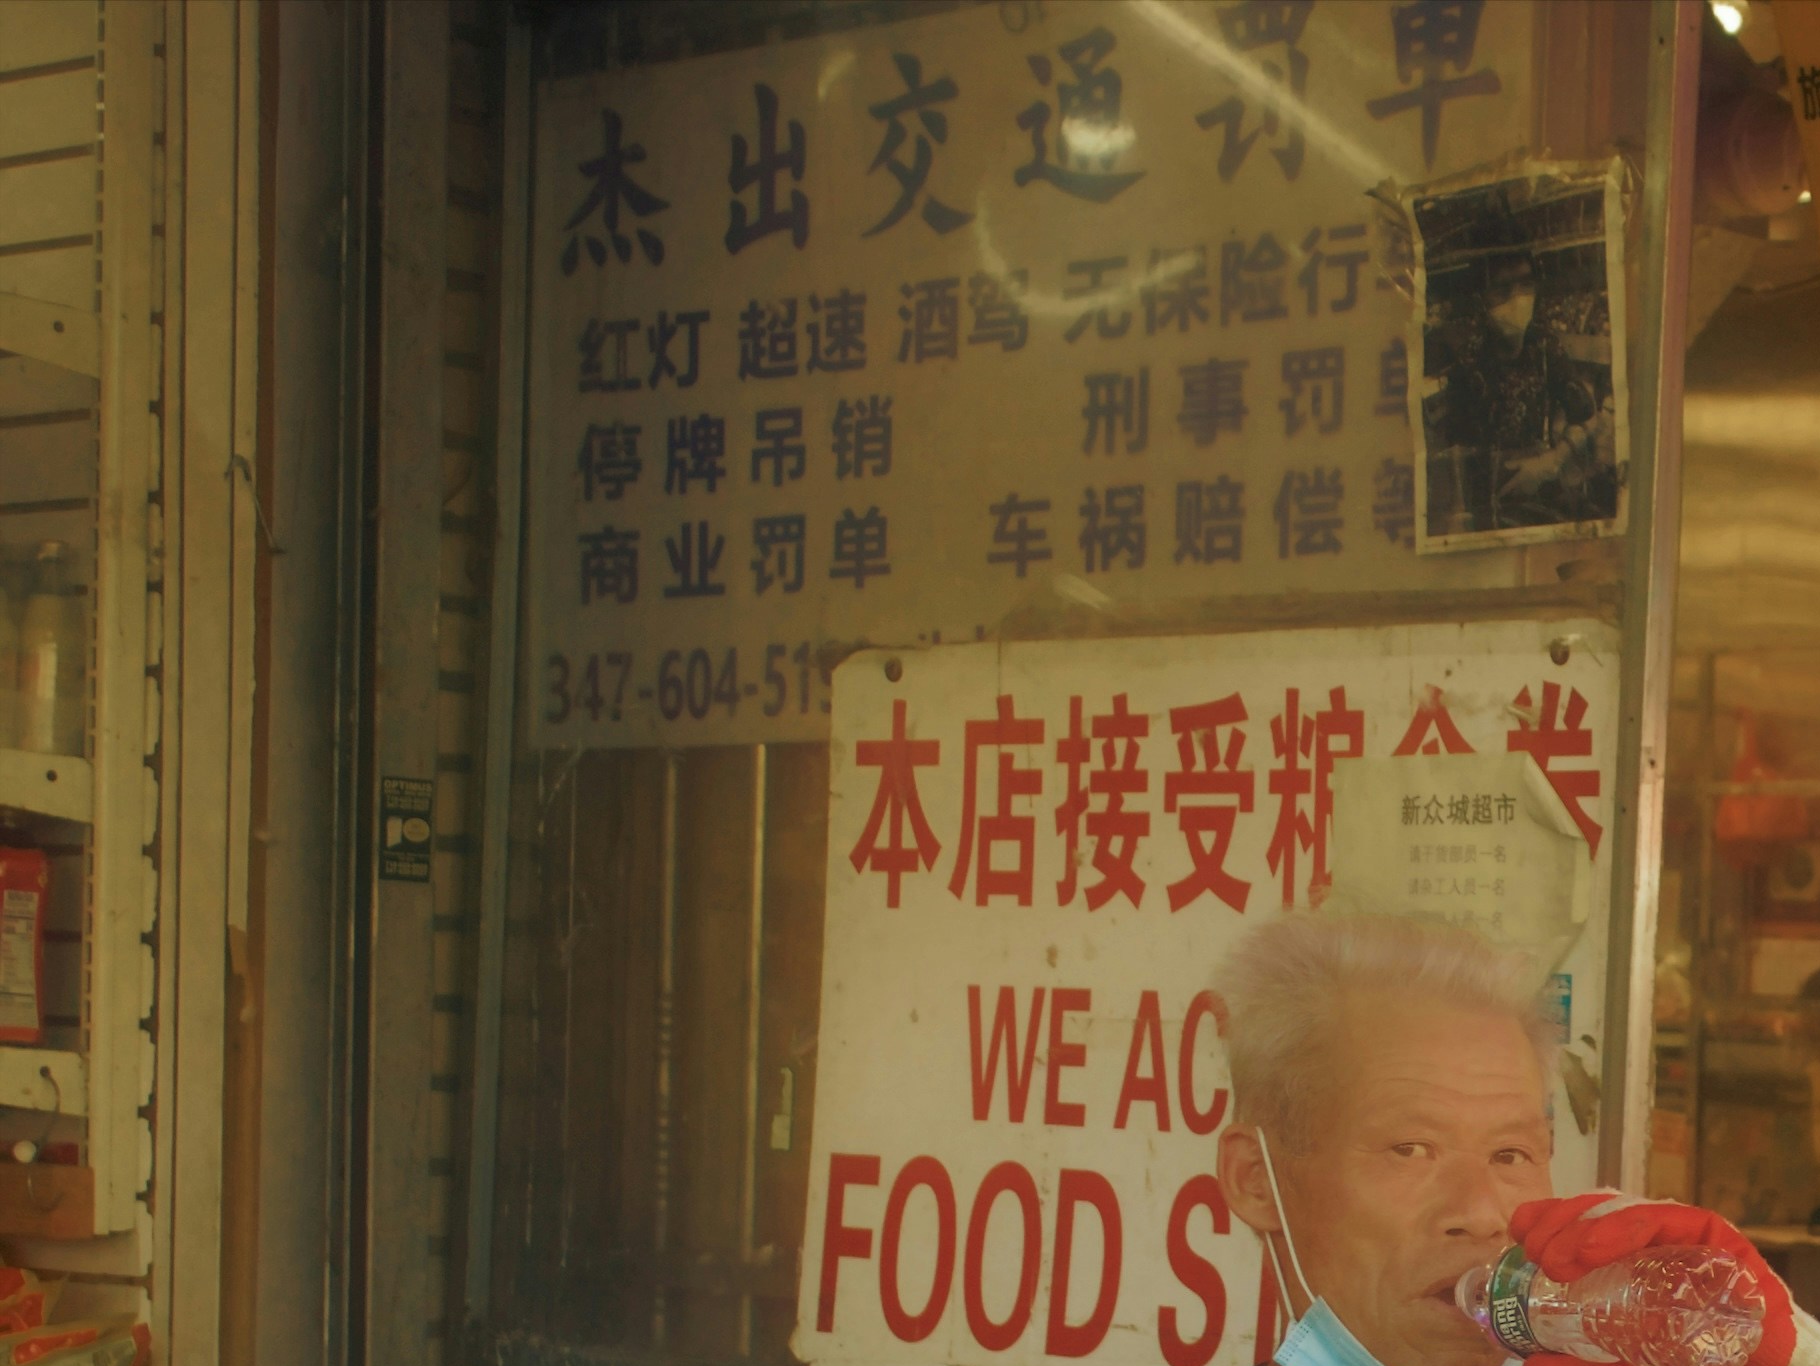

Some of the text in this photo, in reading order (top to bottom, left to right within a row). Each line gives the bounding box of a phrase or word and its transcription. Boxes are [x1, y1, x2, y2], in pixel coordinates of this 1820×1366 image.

[576, 309, 711, 393] 红灯
[737, 289, 868, 381] 超速
[896, 269, 1030, 365] 酒驾
[575, 393, 894, 501] 停牌吊销
[576, 505, 893, 606] 商业罚单
[1401, 792, 1517, 825] 新众城超市
[966, 984, 1092, 1128] WE
[815, 1152, 1124, 1359] FOOD
